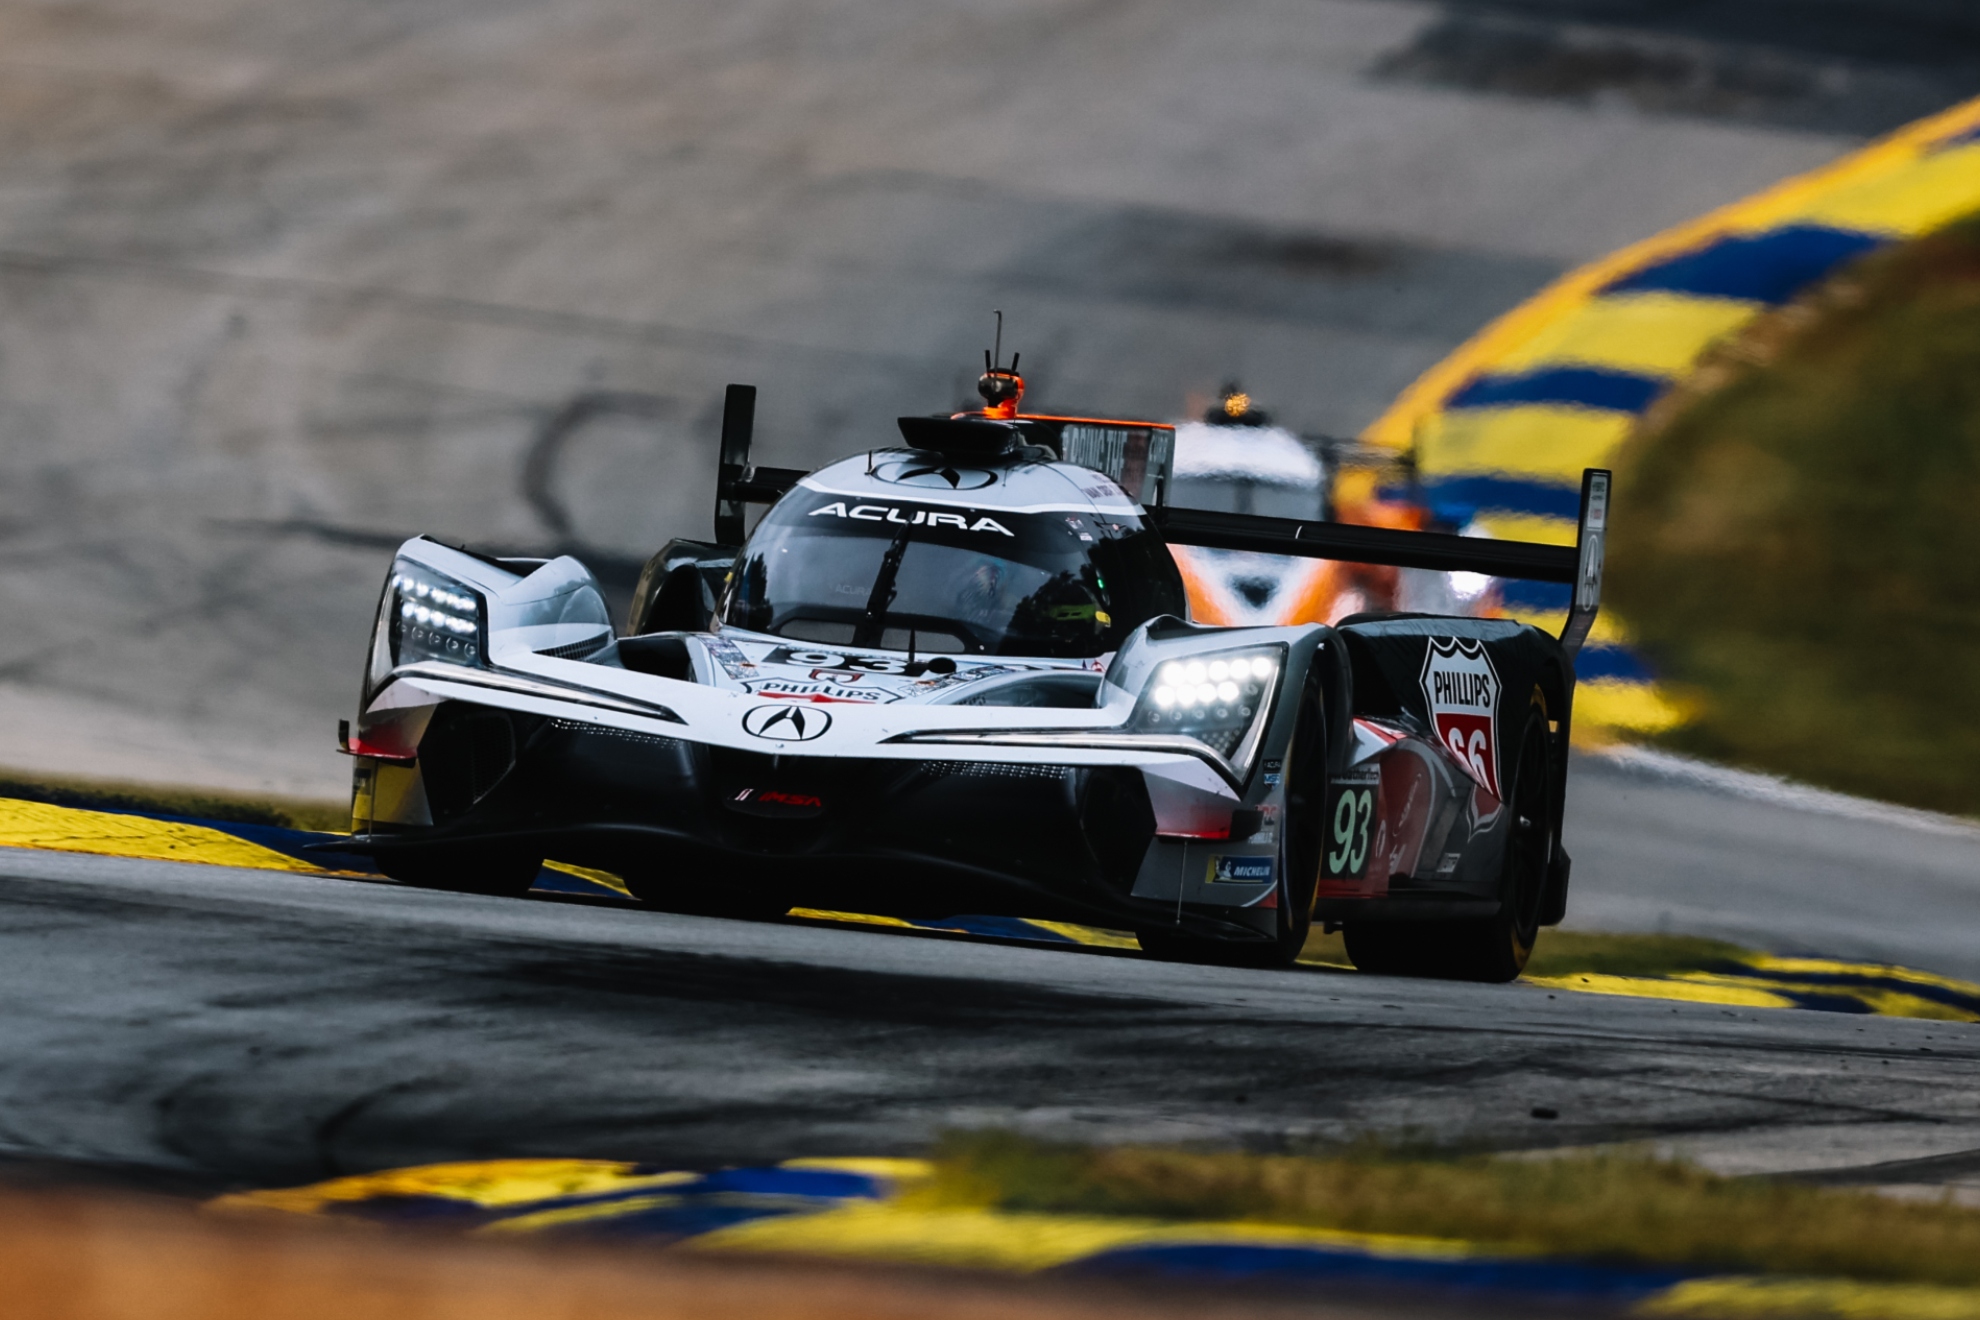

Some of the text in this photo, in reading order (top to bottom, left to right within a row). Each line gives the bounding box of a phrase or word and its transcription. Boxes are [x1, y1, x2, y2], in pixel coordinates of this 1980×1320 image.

[808, 501, 1016, 538] ACURA
[786, 651, 908, 674] 93
[763, 682, 881, 700] PHILLIPS
[1433, 671, 1491, 708] PHILLIPS
[1448, 727, 1494, 795] 66
[1328, 788, 1372, 875] 93
[1233, 865, 1271, 877] MICHELIN
